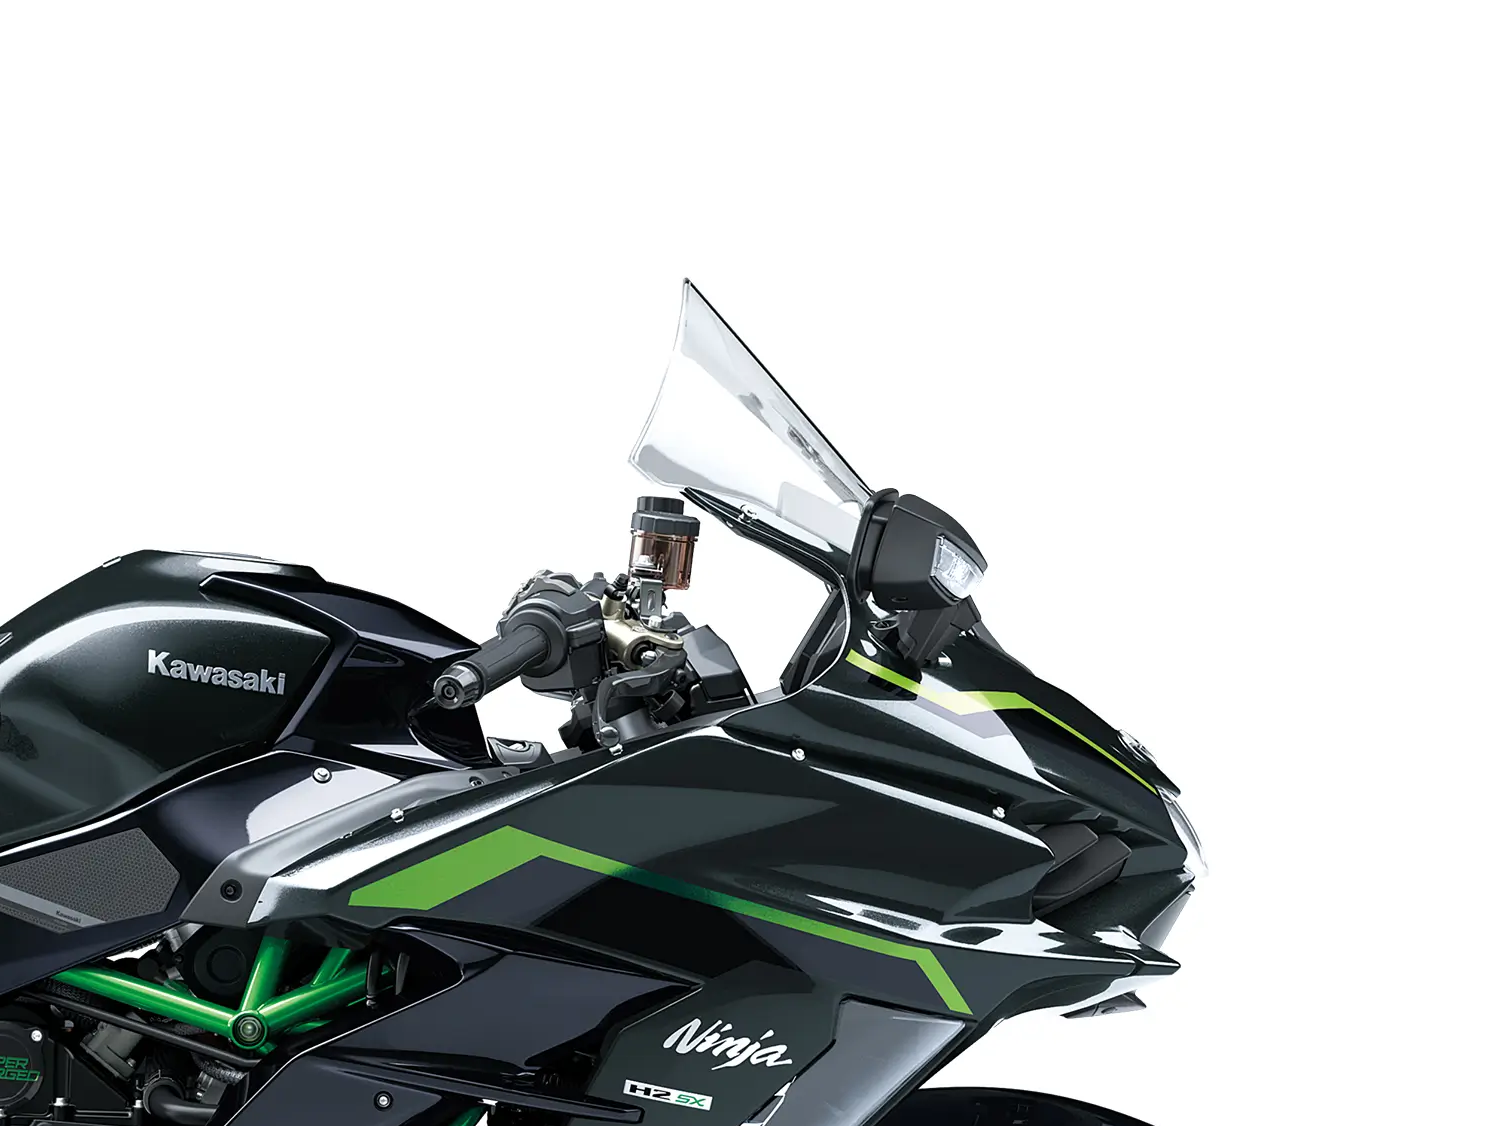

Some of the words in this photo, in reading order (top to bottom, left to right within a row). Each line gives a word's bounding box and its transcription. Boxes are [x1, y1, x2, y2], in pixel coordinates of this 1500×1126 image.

[147, 649, 286, 696] Kawasaki
[662, 1018, 792, 1070] Ninja
[629, 1084, 671, 1101] H2
[675, 1094, 706, 1107] SX
